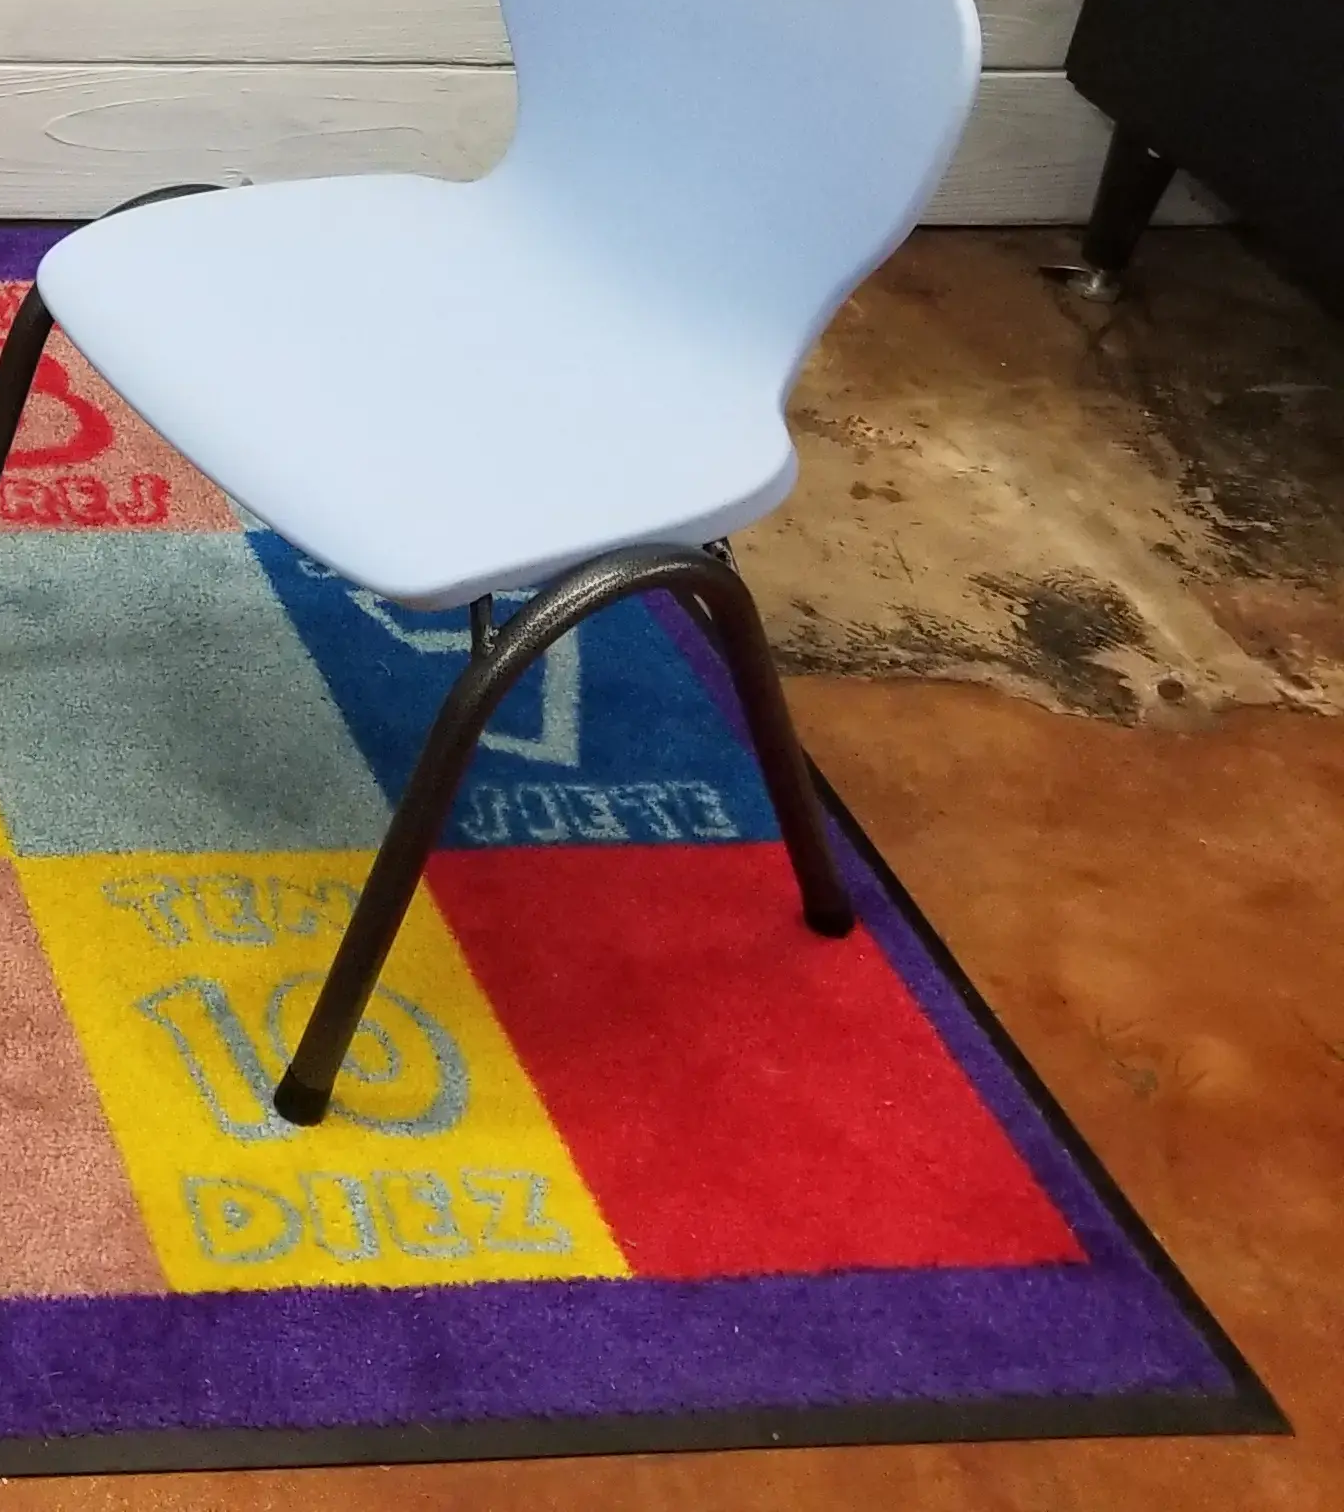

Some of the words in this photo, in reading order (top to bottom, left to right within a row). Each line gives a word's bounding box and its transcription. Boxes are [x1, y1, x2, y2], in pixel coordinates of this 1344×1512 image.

[101, 874, 370, 947] TEN
[132, 970, 470, 1144] 10
[178, 1165, 573, 1263] DIEZ
